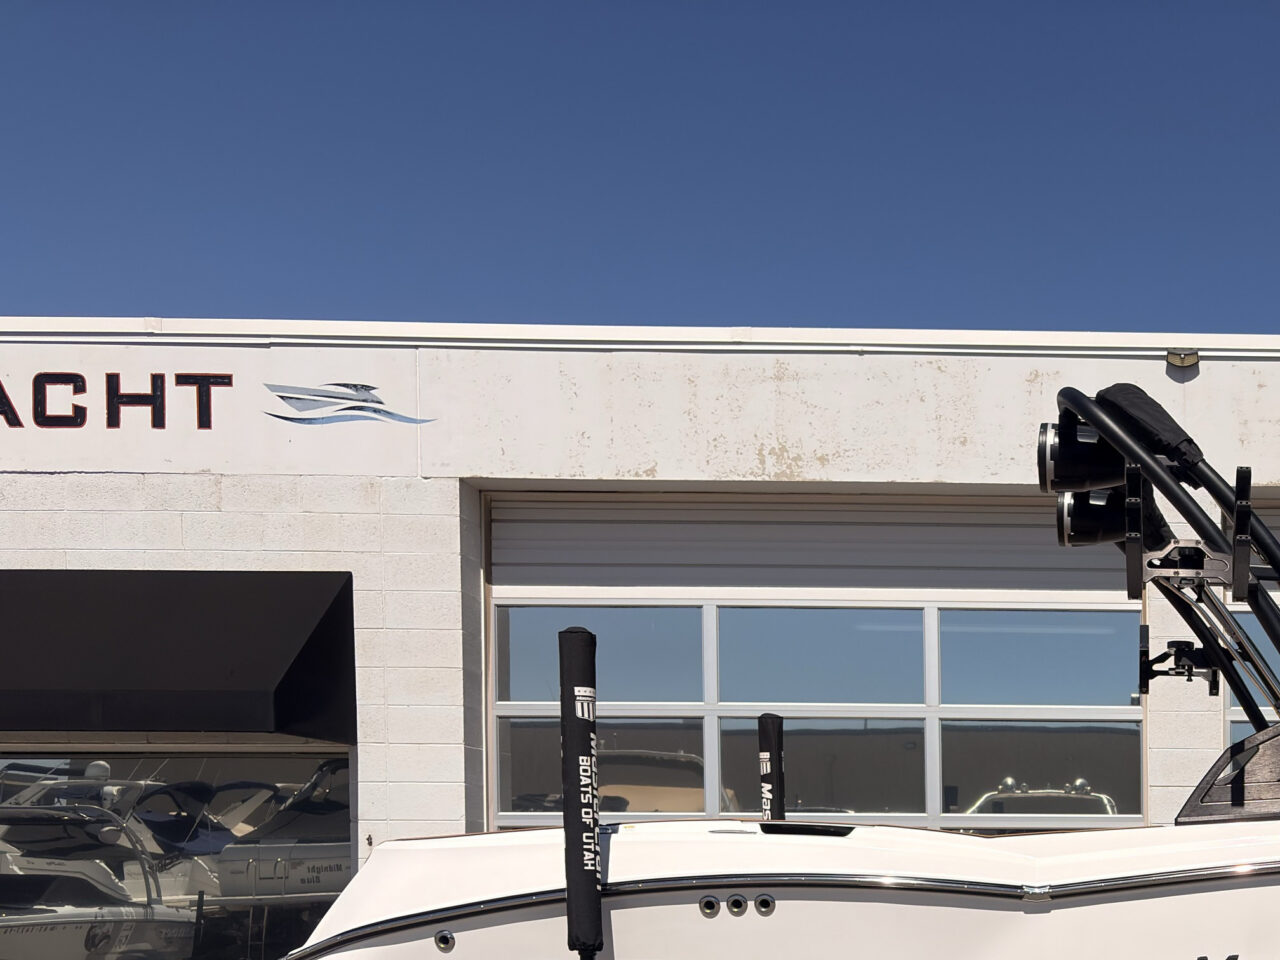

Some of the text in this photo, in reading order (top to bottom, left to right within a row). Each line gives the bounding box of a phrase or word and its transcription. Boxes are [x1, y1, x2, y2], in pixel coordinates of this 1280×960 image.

[578, 756, 596, 870] BOATS OF UTAH
